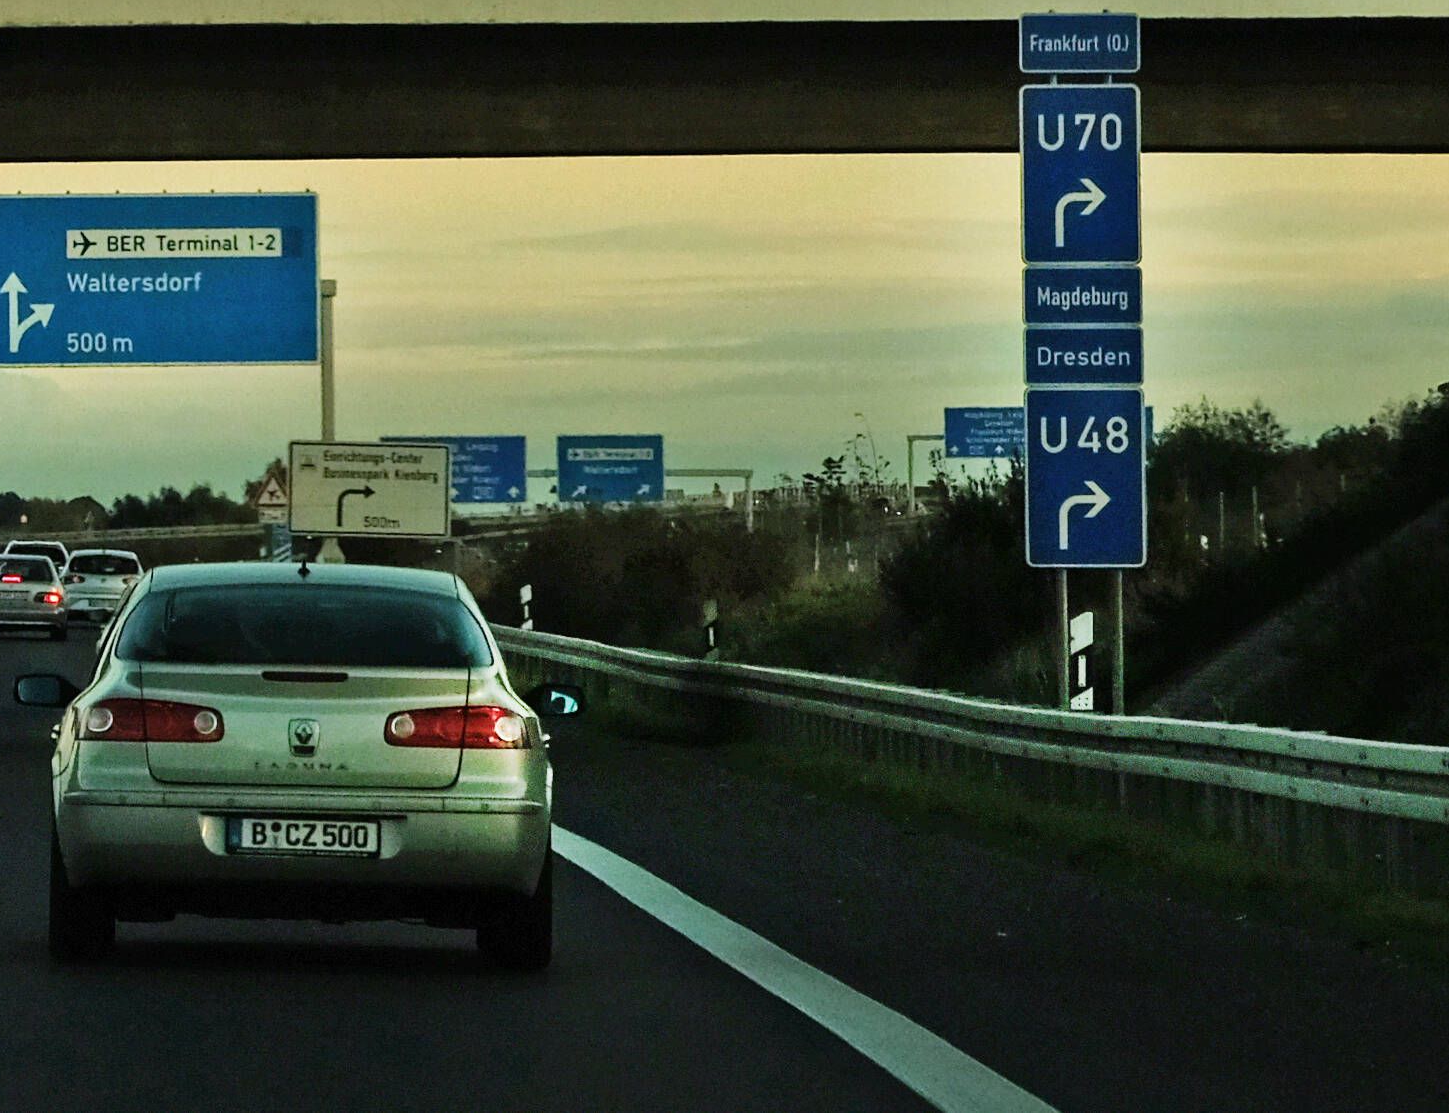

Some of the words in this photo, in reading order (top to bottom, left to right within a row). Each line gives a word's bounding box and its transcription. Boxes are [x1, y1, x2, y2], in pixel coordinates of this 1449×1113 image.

[1029, 34, 1099, 52] Frankfurt
[1107, 33, 1129, 53] (O.)
[1037, 113, 1065, 152] U
[1074, 112, 1122, 152] 70
[106, 235, 145, 252] BER
[156, 234, 239, 251] Terminal
[248, 234, 276, 251] 1-2
[66, 271, 203, 292] Waltersdorf
[1036, 286, 1129, 311] Magdeburg
[66, 332, 107, 353] 500
[112, 336, 134, 353] m
[1036, 346, 1131, 367] Dresden
[1040, 416, 1068, 454] U
[1077, 416, 1130, 454] 48
[251, 822, 267, 845] B
[285, 823, 318, 847] CZ
[321, 824, 369, 849] 500
